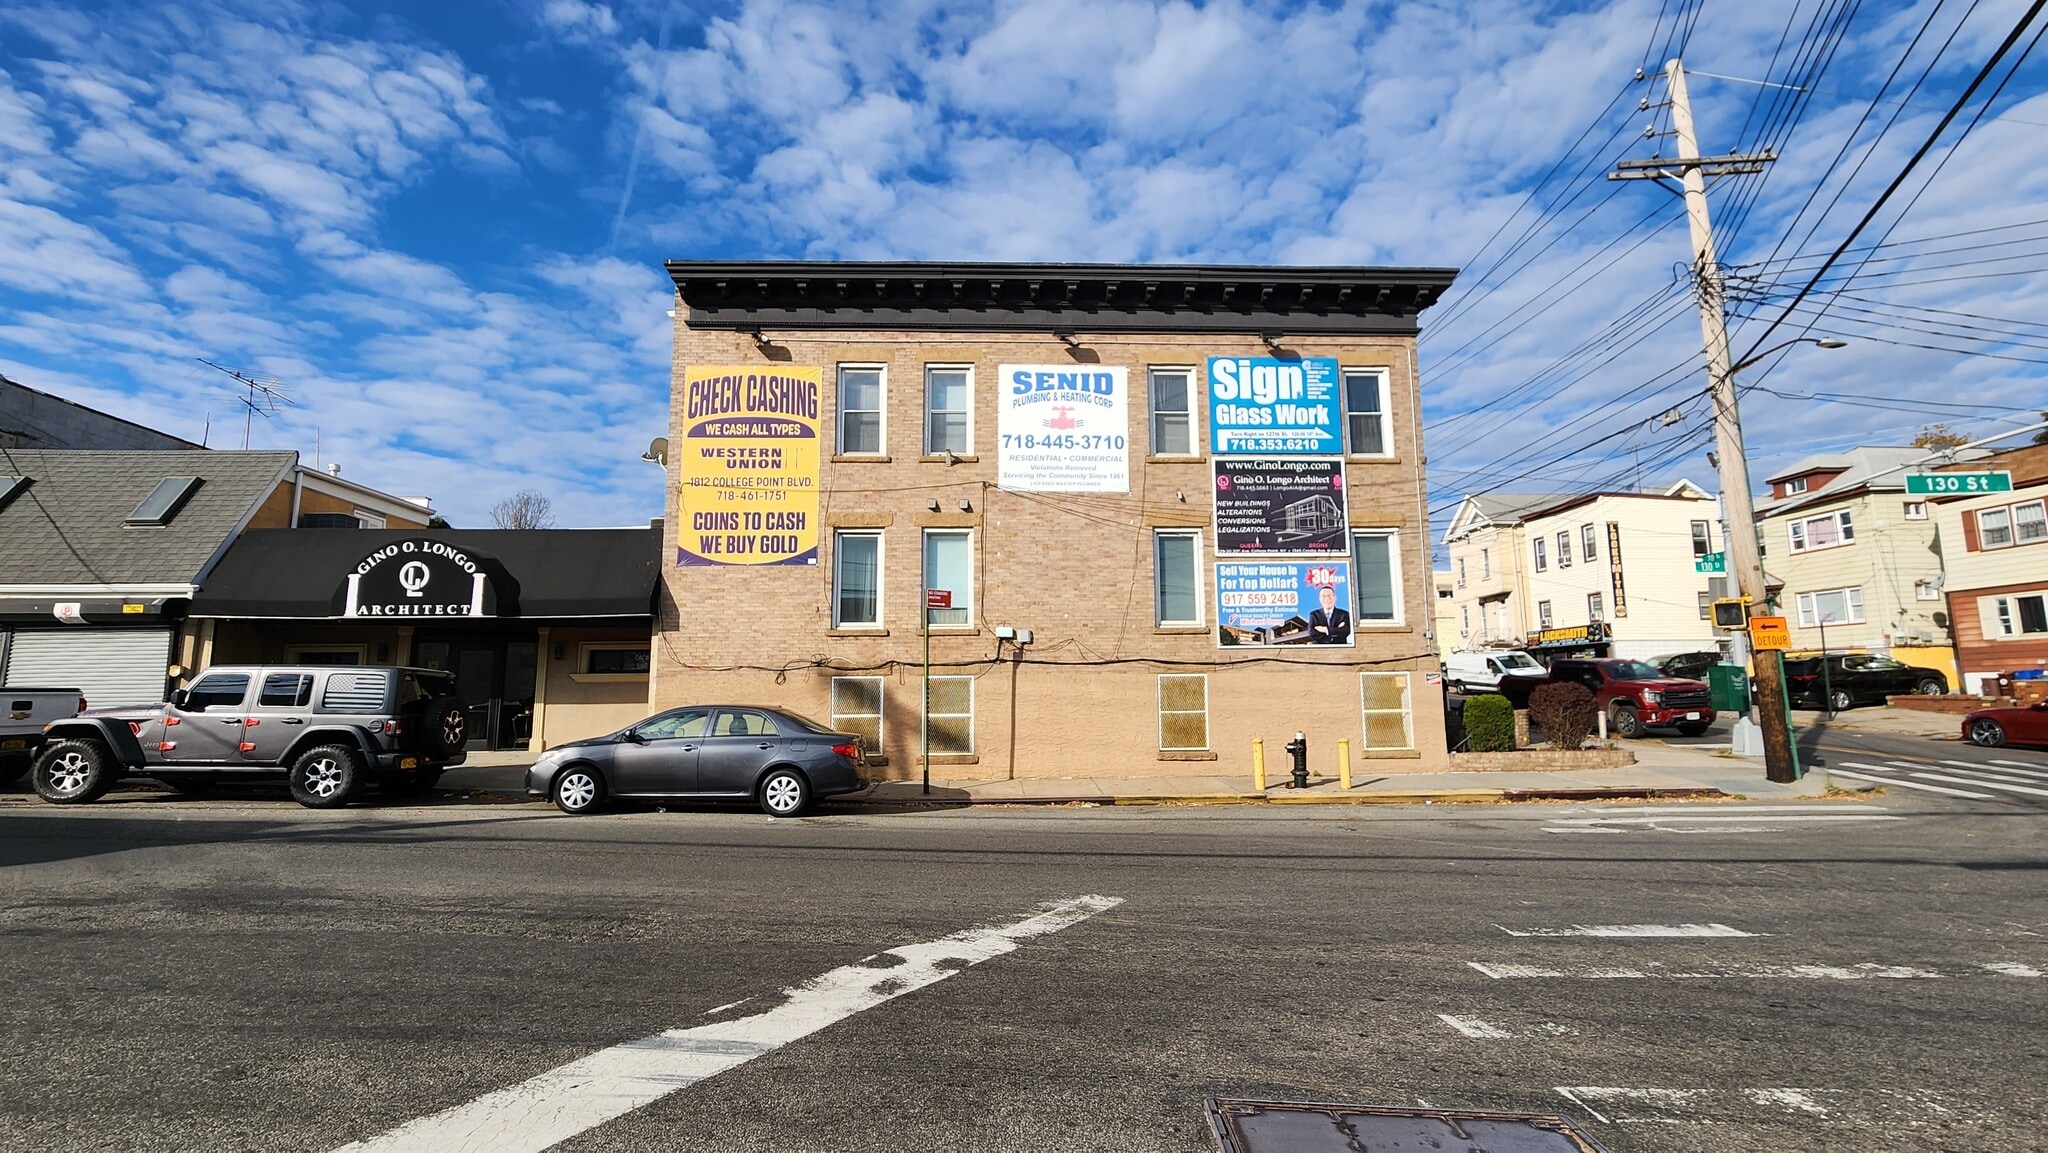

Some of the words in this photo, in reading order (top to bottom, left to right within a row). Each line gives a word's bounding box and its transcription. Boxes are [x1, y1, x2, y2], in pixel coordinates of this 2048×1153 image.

[1012, 371, 1113, 395] SENID
[1213, 359, 1303, 405] Sign
[688, 375, 742, 419] CHECK
[747, 375, 818, 419] CASHING
[1013, 392, 1051, 409] PLUMBING
[1054, 392, 1059, 401] &
[1061, 392, 1092, 404] HEATING
[1094, 395, 1113, 409] CORP
[1216, 404, 1272, 425] Glass
[1275, 404, 1330, 425] Work
[706, 424, 721, 436] WE
[723, 424, 750, 436] CASH
[751, 424, 769, 436] ALL
[770, 424, 801, 436] TYPES
[1002, 435, 1124, 450] 718-445-3710
[1231, 439, 1319, 450] 718.353.6210
[701, 448, 782, 458] WESTERN
[726, 459, 782, 469] UNION
[1226, 461, 1331, 472] www.GinoLongo.com
[690, 477, 710, 487] 1812
[713, 477, 754, 487] COLLEGE
[757, 477, 784, 487] POINT
[787, 477, 814, 487] BLVD.
[1234, 476, 1254, 484] Gino
[1255, 476, 1265, 484] O.
[1267, 476, 1292, 485] Longo
[1294, 476, 1330, 484] Architect
[1926, 477, 1959, 491] 130
[1967, 476, 1989, 490] St
[718, 491, 787, 501] 718-461-1751
[694, 512, 739, 531] COINS
[744, 512, 763, 531] TO
[766, 512, 806, 531] CASH
[700, 536, 722, 554] WE
[727, 536, 756, 554] BUY
[761, 536, 798, 554] GOLD
[358, 545, 398, 575] GINO
[402, 541, 418, 553] O.
[423, 541, 477, 574] LONGO
[1220, 566, 1237, 576] Sell
[1239, 566, 1258, 576] Your
[1260, 566, 1287, 576] House
[1701, 562, 1713, 572] 130
[1312, 569, 1329, 584] 30
[1329, 575, 1346, 584] days
[1221, 578, 1237, 589] For
[1239, 578, 1258, 590] Top
[1224, 594, 1243, 604] 917
[1248, 594, 1267, 604] 559
[1271, 593, 1297, 604] 2418
[358, 605, 471, 616] ARCHITECT
[1757, 635, 1788, 646] DETOUR
